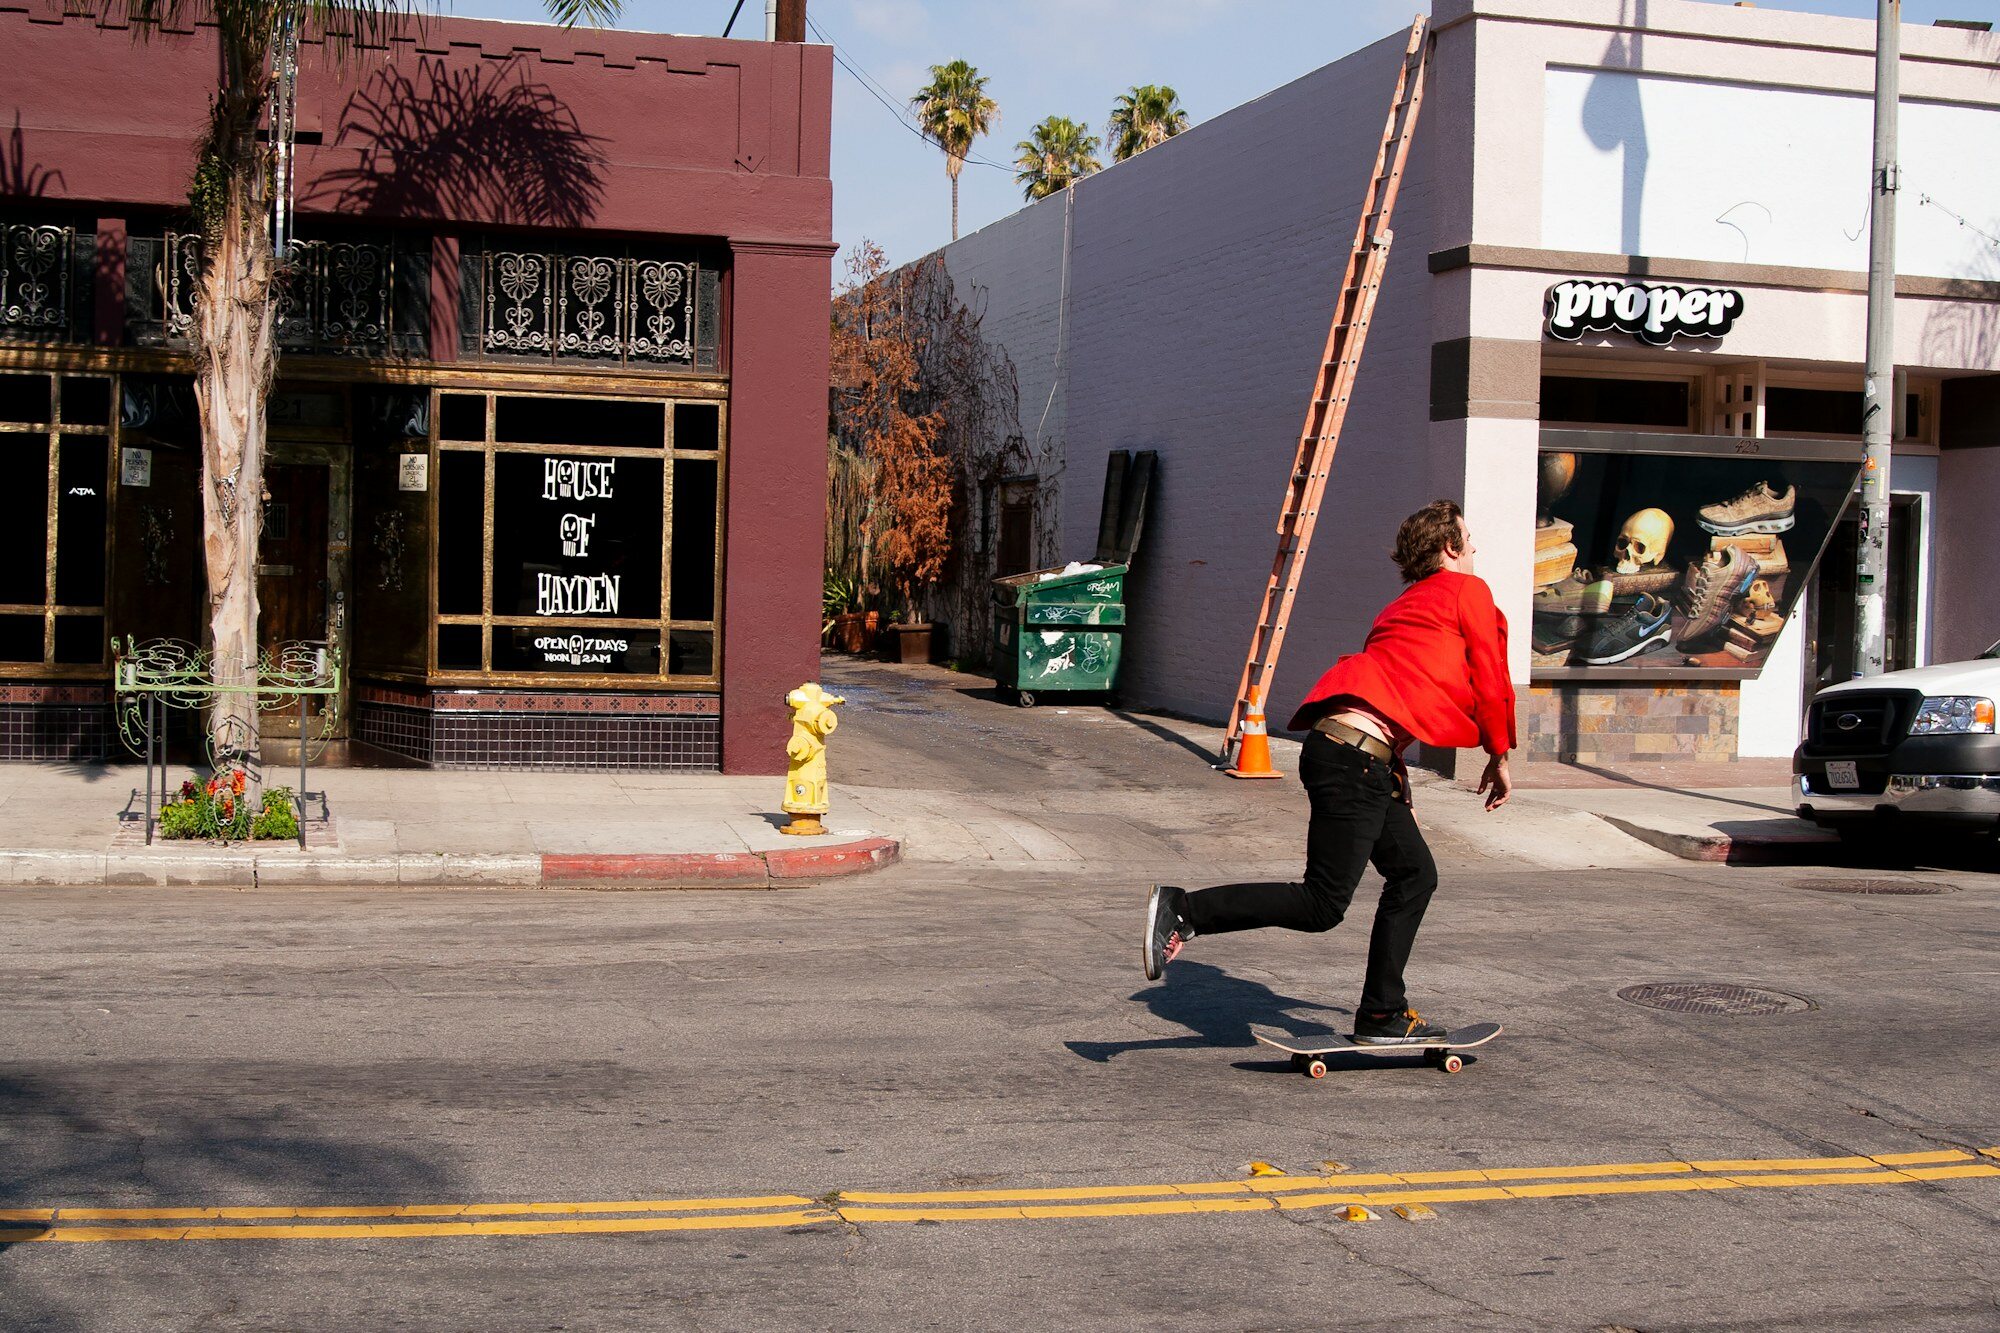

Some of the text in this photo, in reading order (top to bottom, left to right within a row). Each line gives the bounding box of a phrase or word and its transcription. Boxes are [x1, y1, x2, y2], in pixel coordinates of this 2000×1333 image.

[1553, 282, 1735, 333] proper
[1735, 440, 1760, 453] 425
[69, 487, 96, 496] ATM
[542, 458, 615, 500] HOUSE
[560, 513, 595, 557] OF
[536, 572, 621, 615] HAYDEN
[534, 637, 628, 651] OPEN 7 DAYS
[544, 653, 612, 663] NOON 2AM
